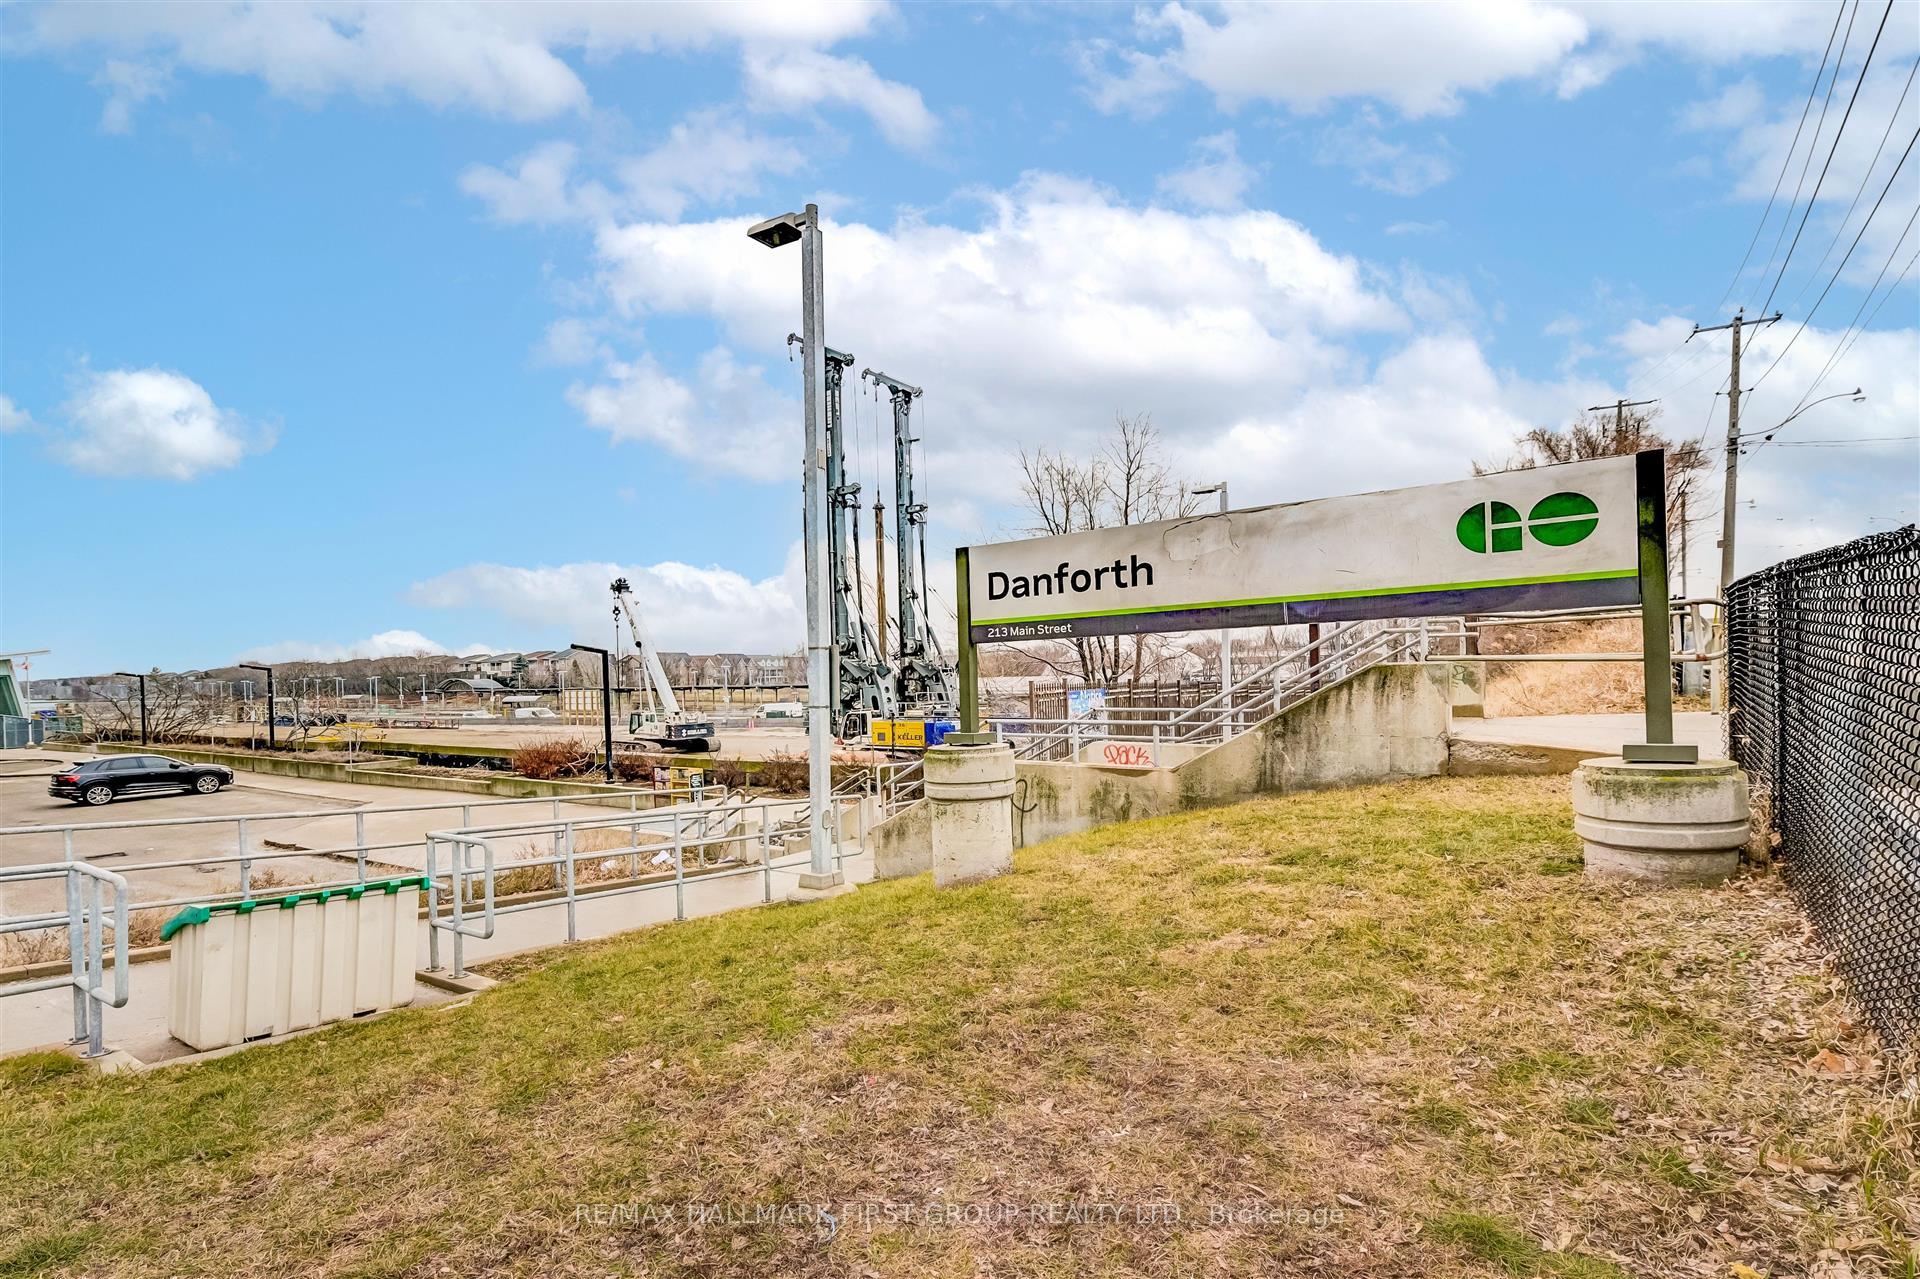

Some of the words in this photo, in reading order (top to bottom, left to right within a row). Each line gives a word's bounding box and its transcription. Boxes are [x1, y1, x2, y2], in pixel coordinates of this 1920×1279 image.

[1457, 492, 1599, 553] GO
[988, 555, 1153, 600] Danforth
[987, 627, 1008, 638] 213
[1010, 625, 1035, 637] Main
[1038, 623, 1073, 635] Street
